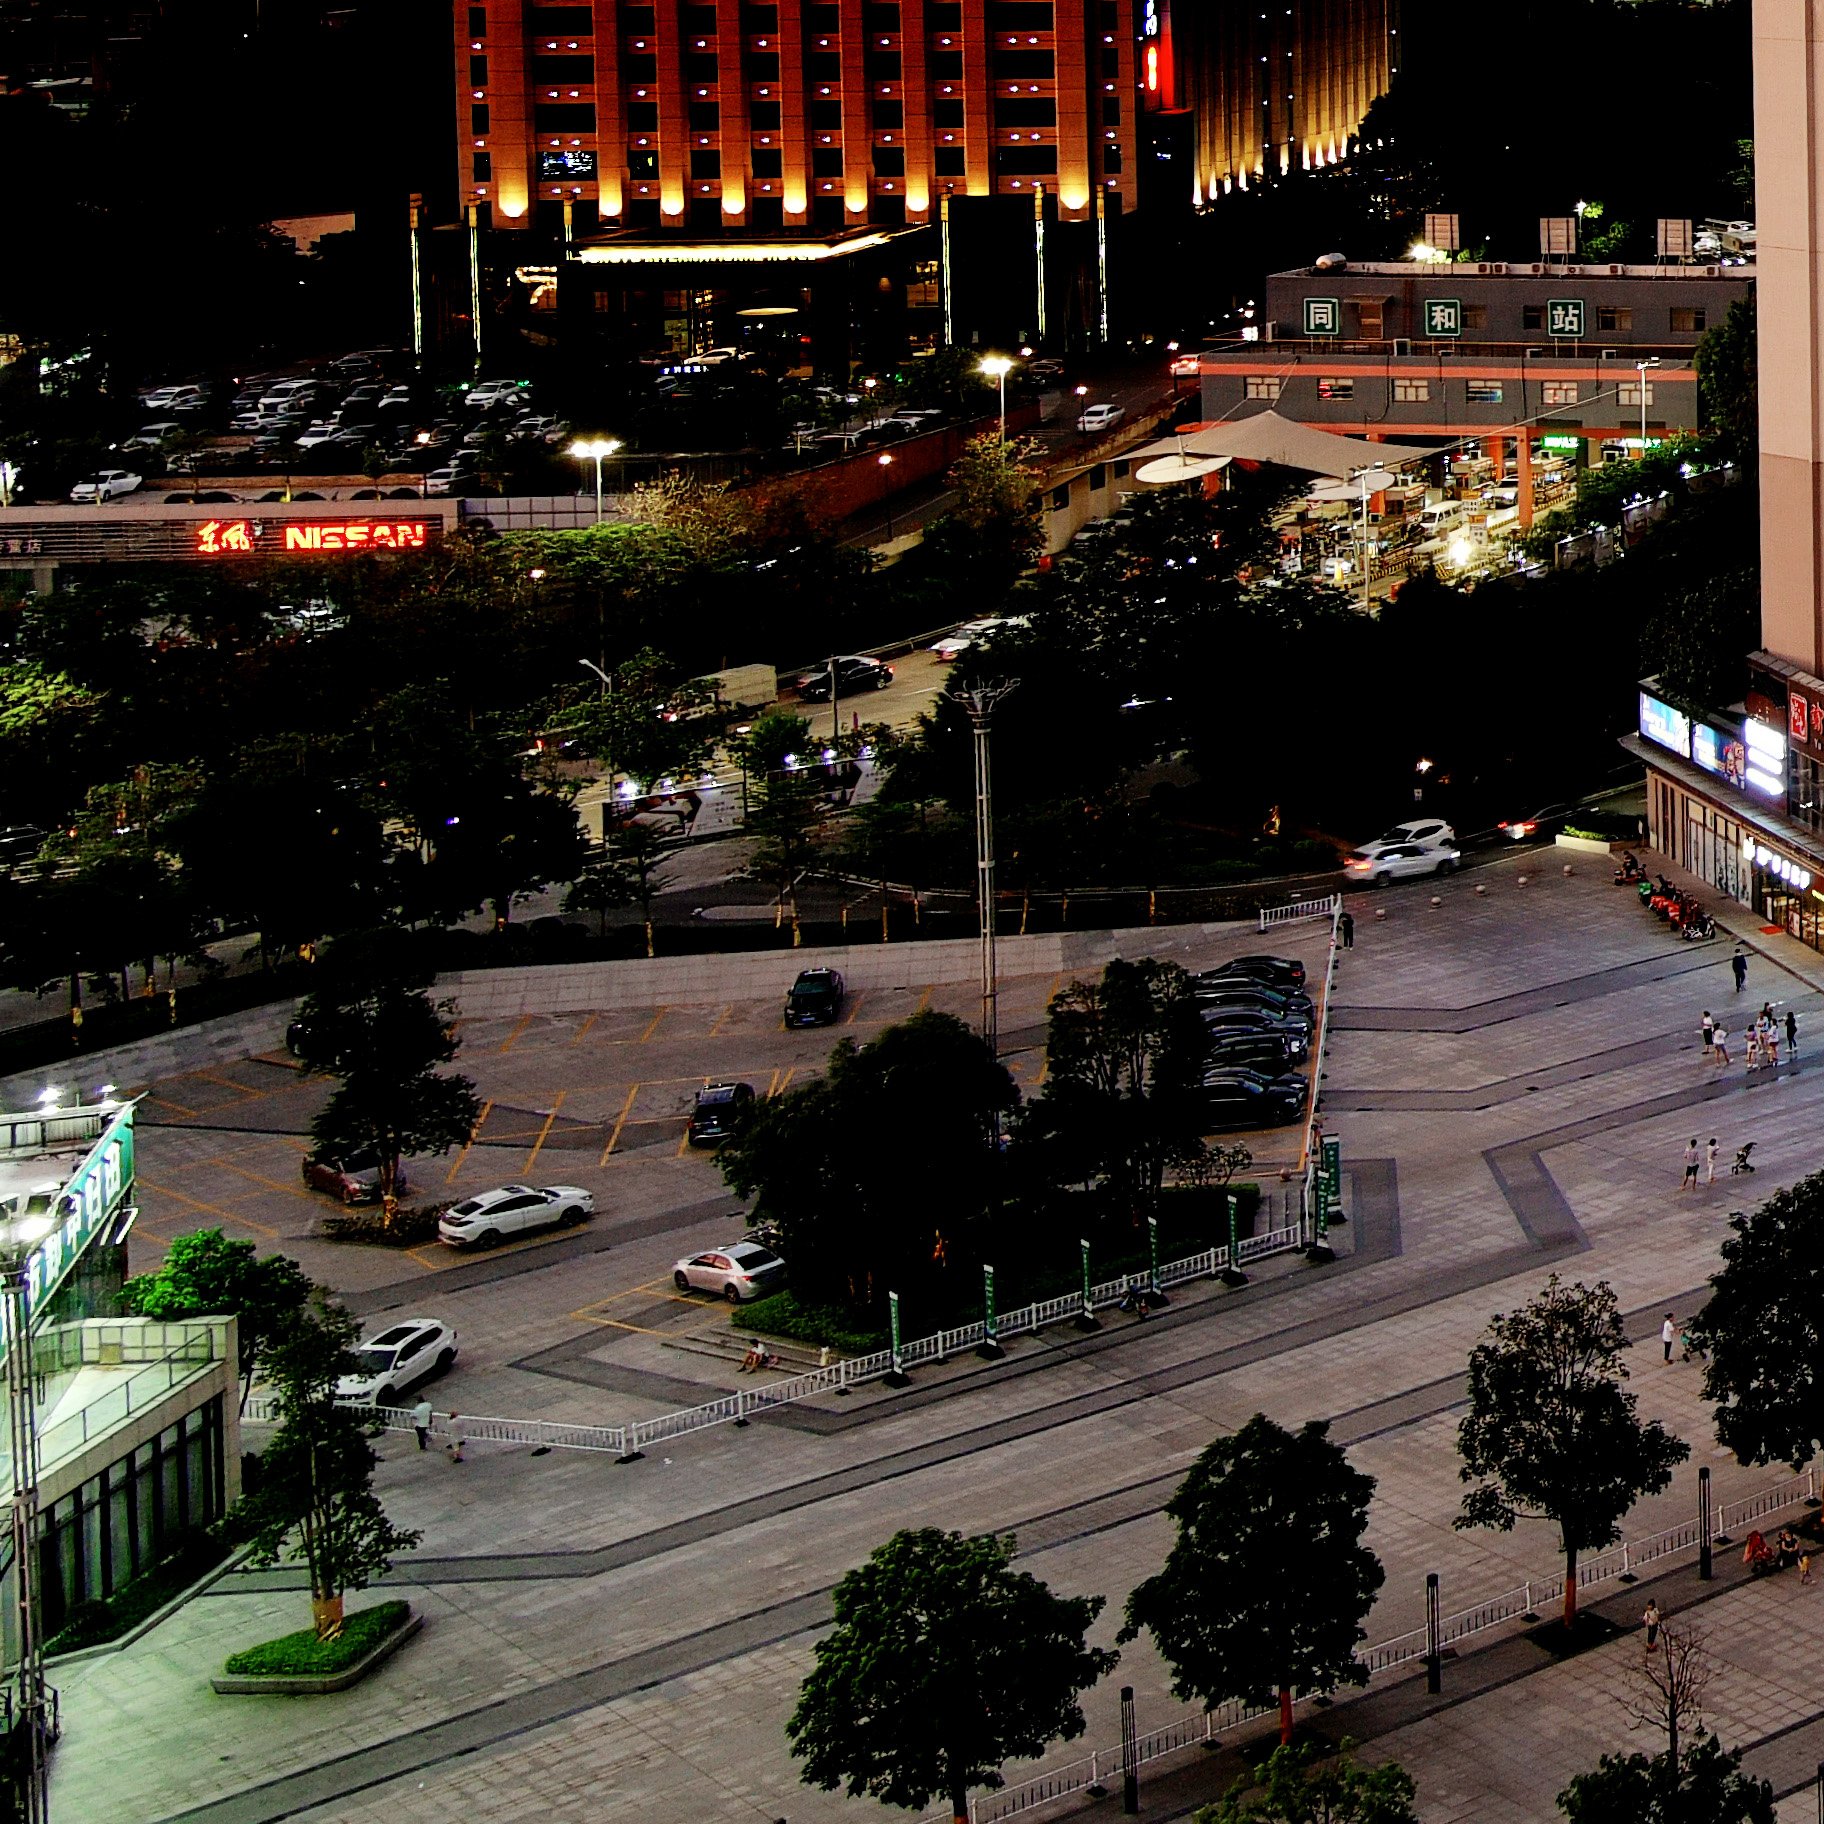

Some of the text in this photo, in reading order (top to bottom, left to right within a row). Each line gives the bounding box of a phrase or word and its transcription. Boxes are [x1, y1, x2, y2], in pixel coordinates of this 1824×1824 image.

[1310, 303, 1579, 332] 同和站
[198, 521, 250, 552] 东风
[286, 524, 424, 550] NISSAN
